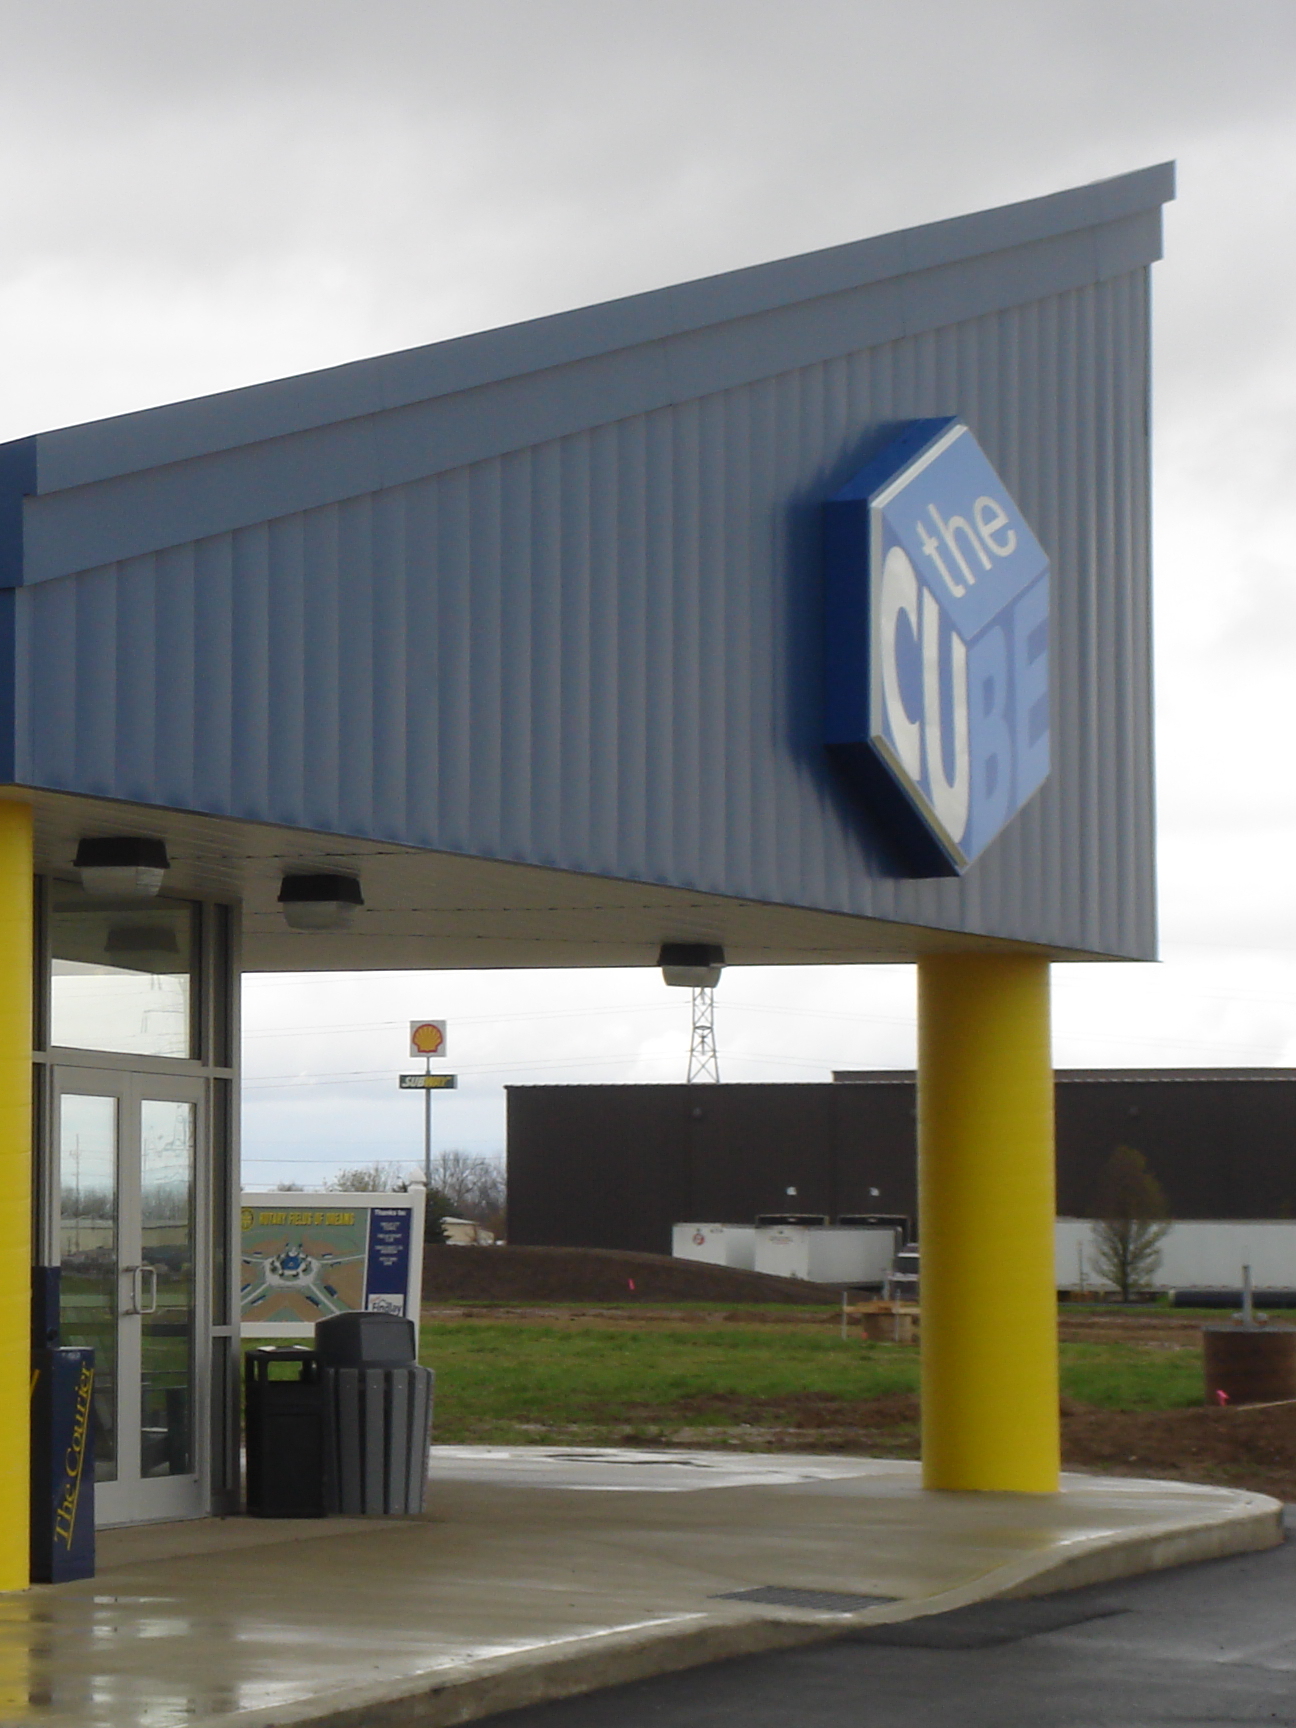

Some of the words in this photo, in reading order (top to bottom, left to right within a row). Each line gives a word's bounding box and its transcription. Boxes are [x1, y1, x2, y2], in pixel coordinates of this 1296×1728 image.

[916, 496, 1018, 598] the
[880, 546, 1051, 859] CUBE
[402, 1076, 452, 1088] SUBWAY
[259, 1212, 287, 1225] ROTARY
[289, 1212, 313, 1225] FIELDS
[314, 1212, 325, 1225] OF
[326, 1212, 355, 1225] DREAMS
[54, 1484, 76, 1542] The
[65, 1361, 91, 1477] Courier
